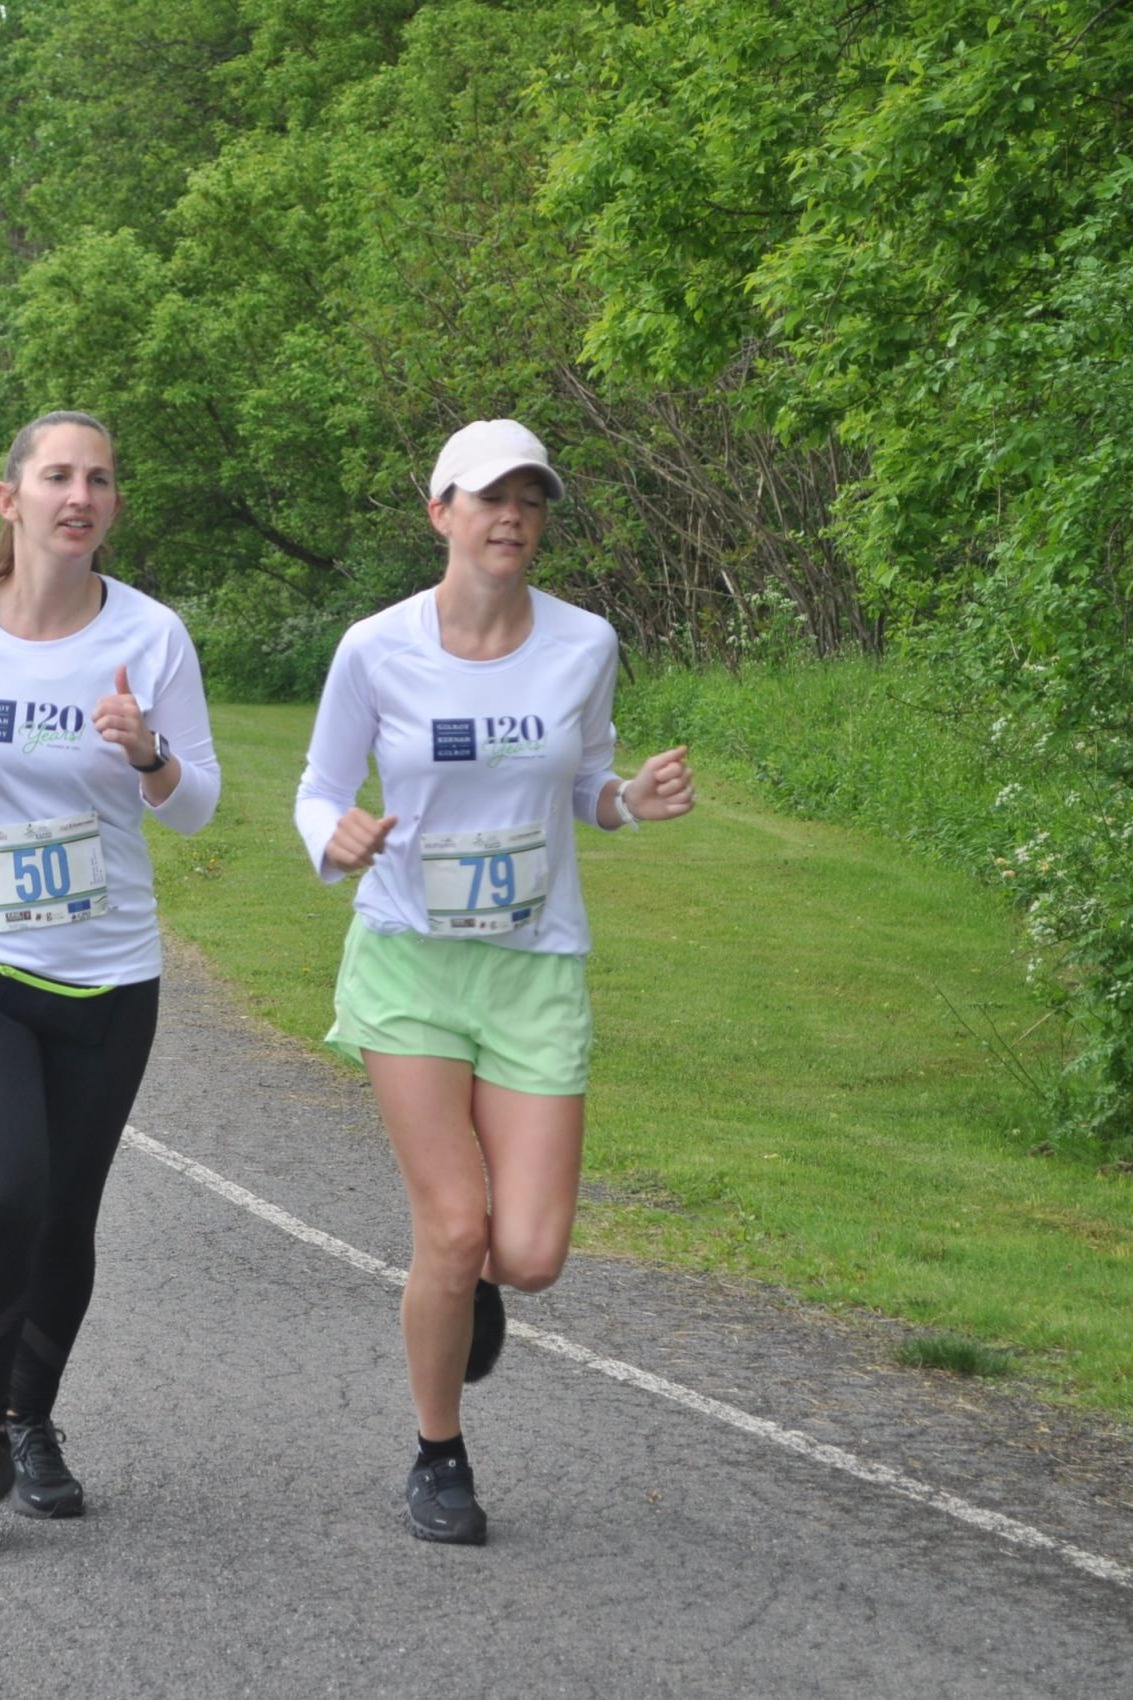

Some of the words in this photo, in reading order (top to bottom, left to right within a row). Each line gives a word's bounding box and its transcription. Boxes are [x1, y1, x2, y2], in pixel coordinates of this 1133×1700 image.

[25, 702, 84, 733] 120
[483, 714, 545, 744] 120
[13, 843, 71, 902] 50
[459, 852, 516, 911] 79
